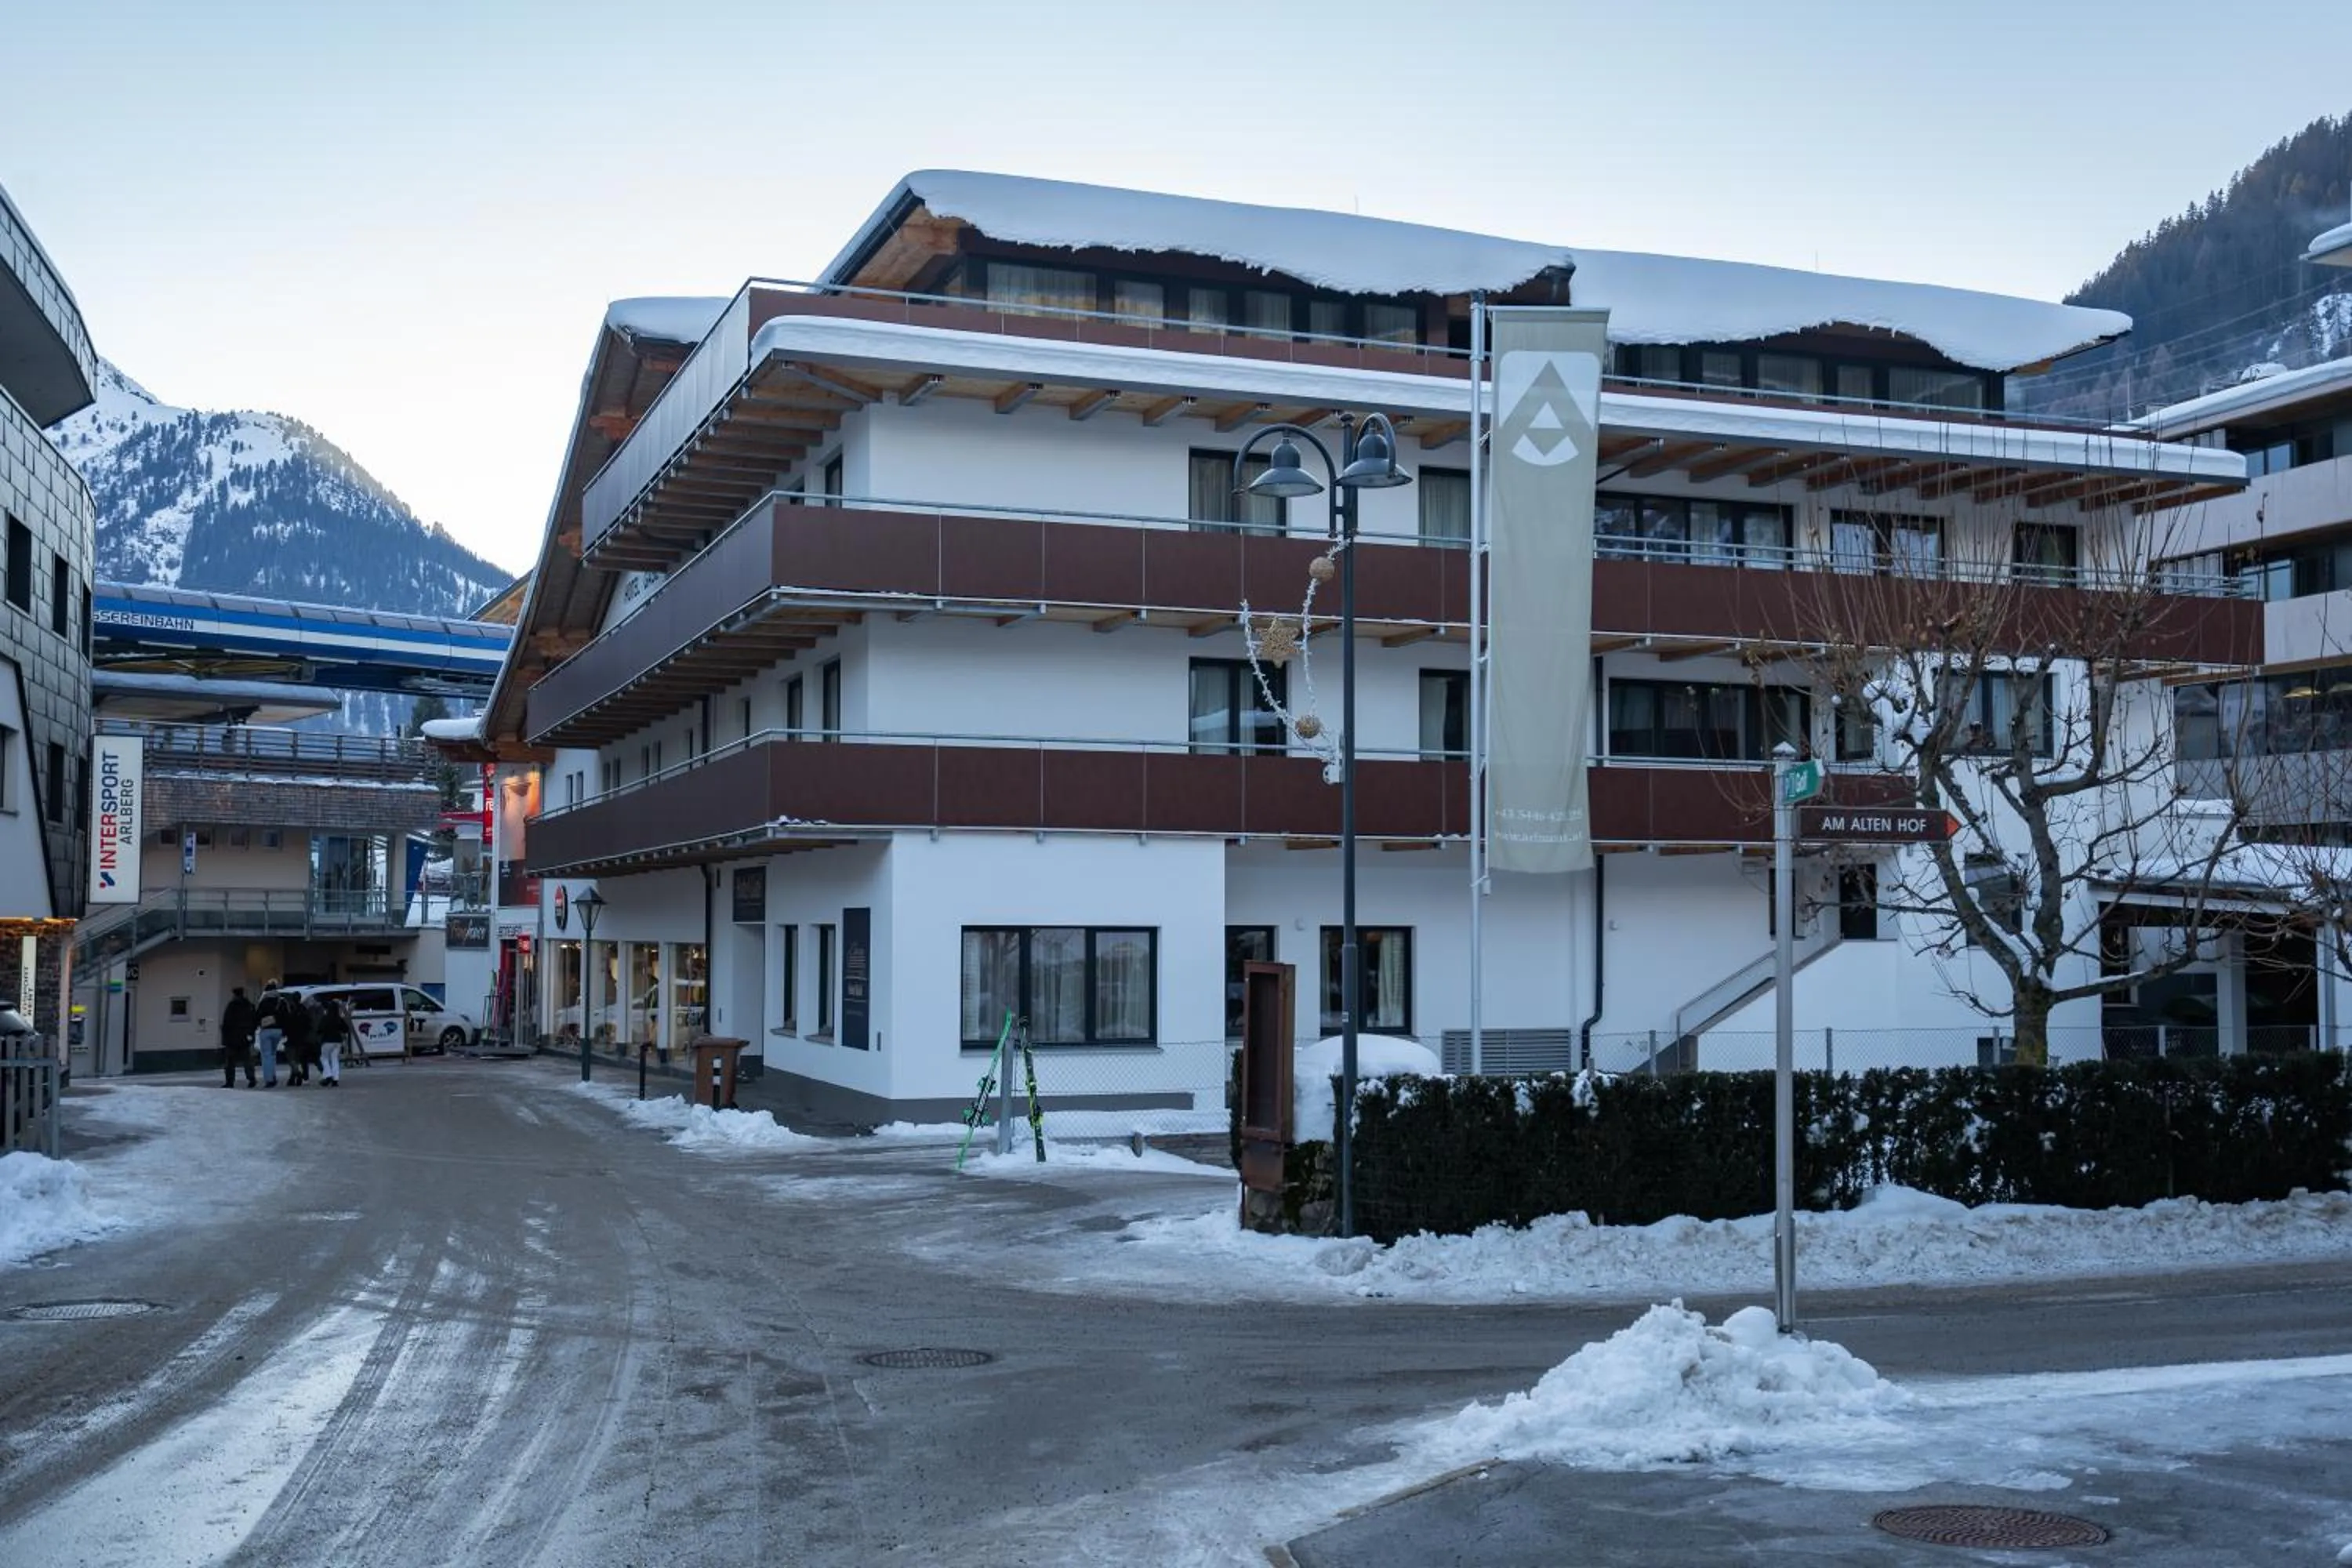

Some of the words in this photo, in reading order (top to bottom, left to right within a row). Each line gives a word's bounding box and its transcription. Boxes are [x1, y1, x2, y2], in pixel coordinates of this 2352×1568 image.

[100, 750, 119, 869] INTERSPORT
[120, 778, 135, 844] ARLBERG
[1821, 816, 1845, 831] AM
[1850, 817, 1892, 833] ALTEN
[1898, 818, 1927, 833] HOF
